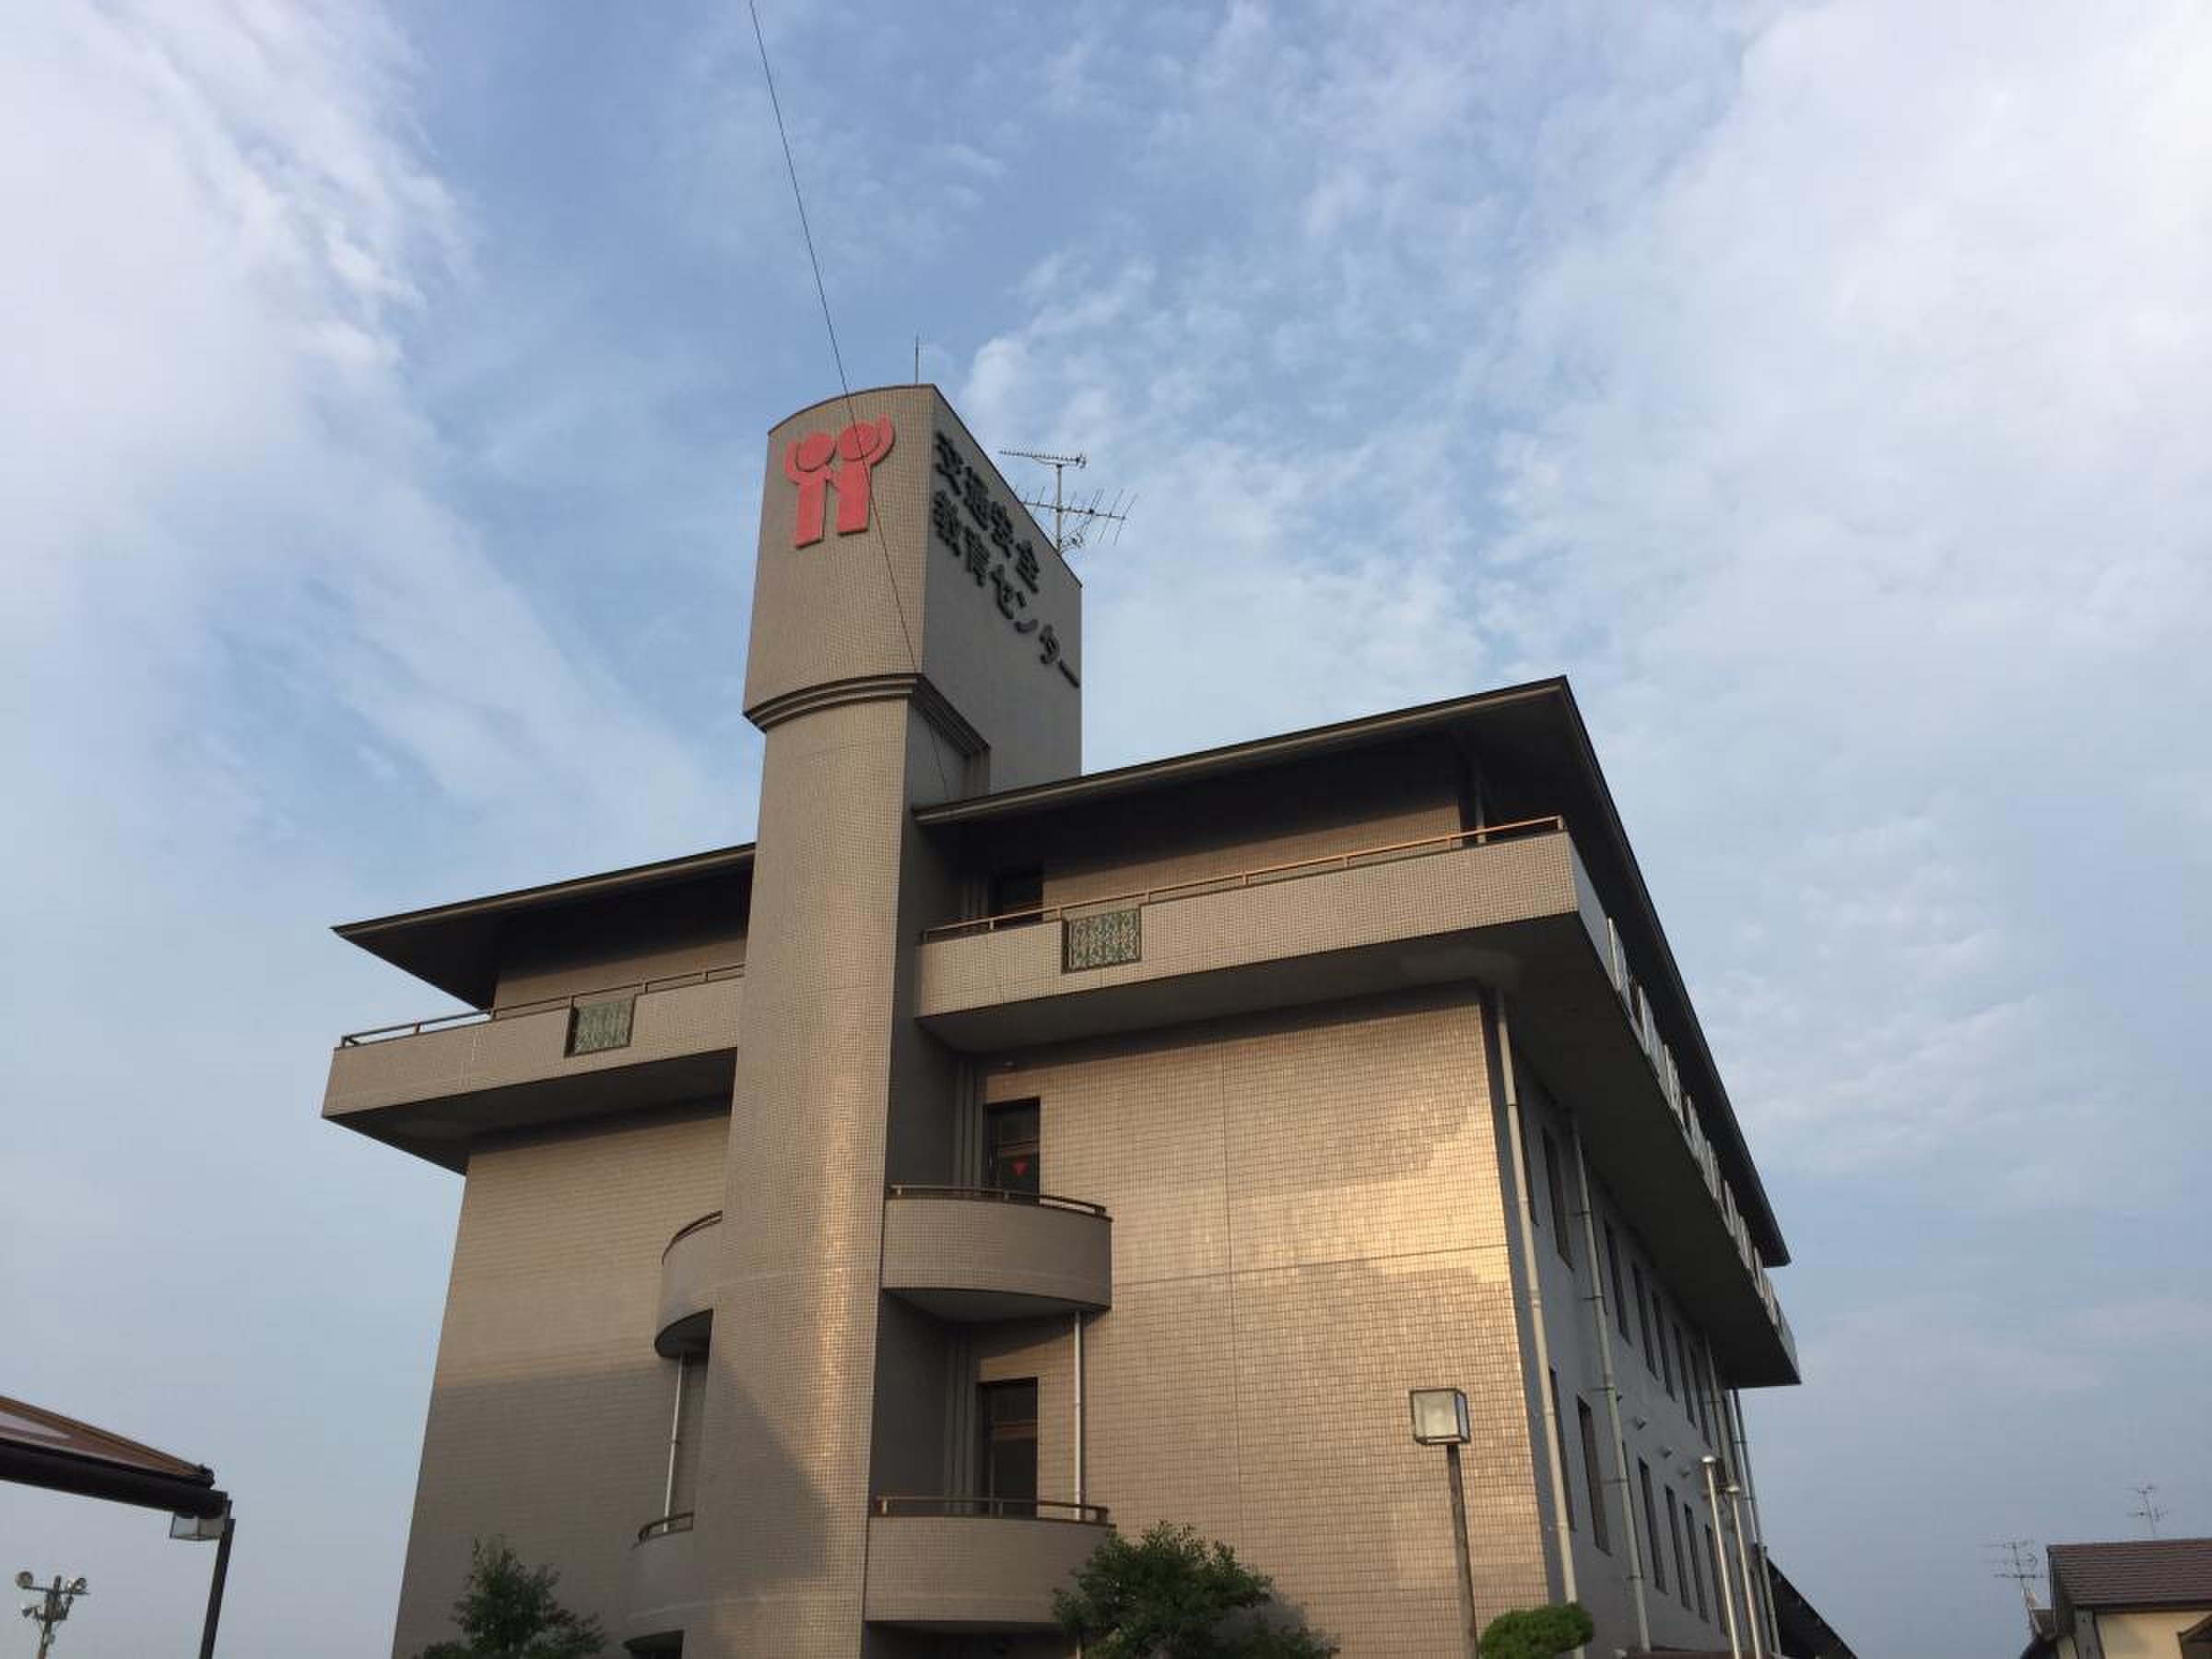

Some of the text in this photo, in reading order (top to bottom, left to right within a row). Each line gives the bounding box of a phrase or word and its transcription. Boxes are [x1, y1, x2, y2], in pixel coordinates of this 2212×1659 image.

[933, 489, 1080, 688] 教育センター
[935, 429, 1040, 594] 交通安全
